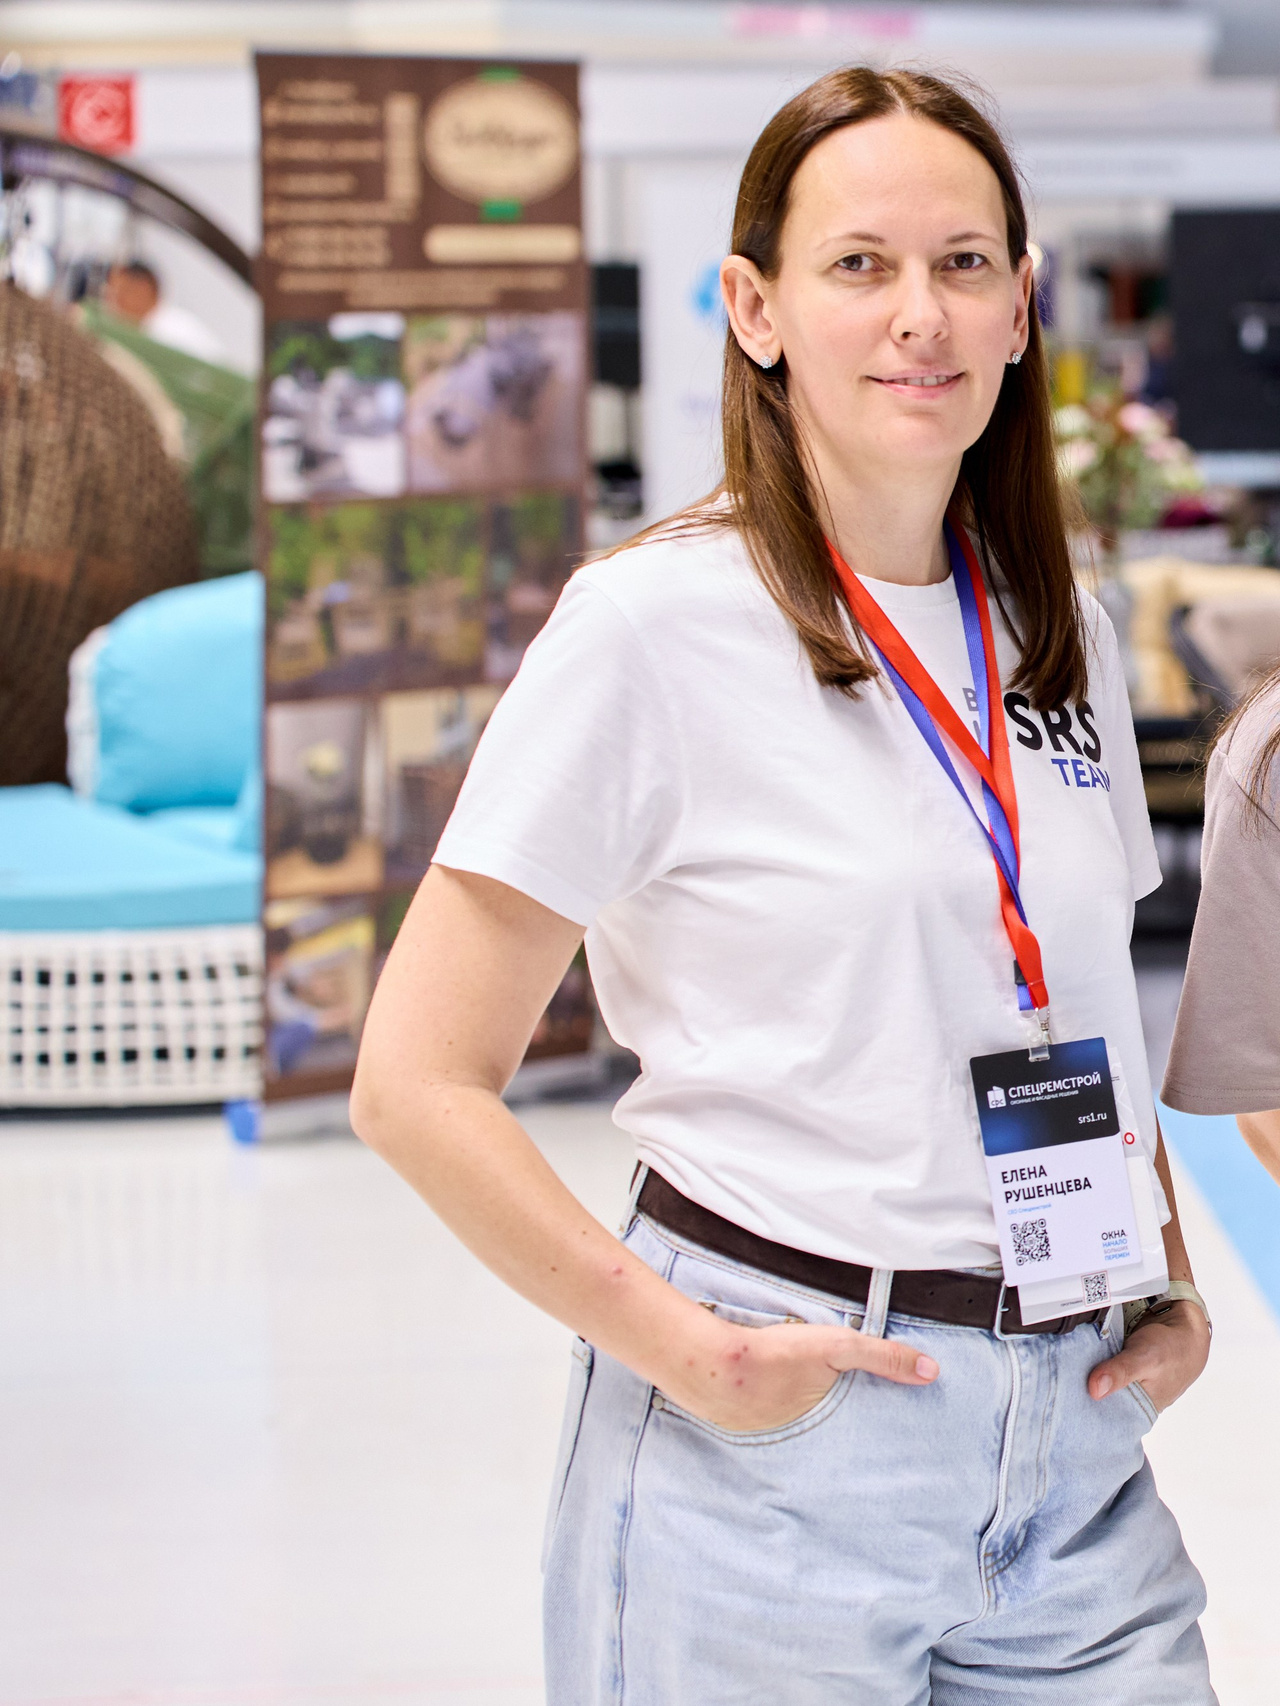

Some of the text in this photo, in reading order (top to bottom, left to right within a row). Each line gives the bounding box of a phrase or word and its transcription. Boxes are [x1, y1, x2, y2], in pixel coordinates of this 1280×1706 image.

[1003, 691, 1101, 763] SRS
[1008, 1071, 1101, 1098] СПЕЦРЕМСТРОЙ
[1078, 1112, 1107, 1124] srs1.ru
[1001, 1165, 1047, 1184] ЕЛЕНА
[1004, 1177, 1092, 1203] РУШЕНЦЕВА
[1102, 1238, 1127, 1248] НАЧАЛО
[1104, 1252, 1130, 1261] ПЕРЕМЕН
